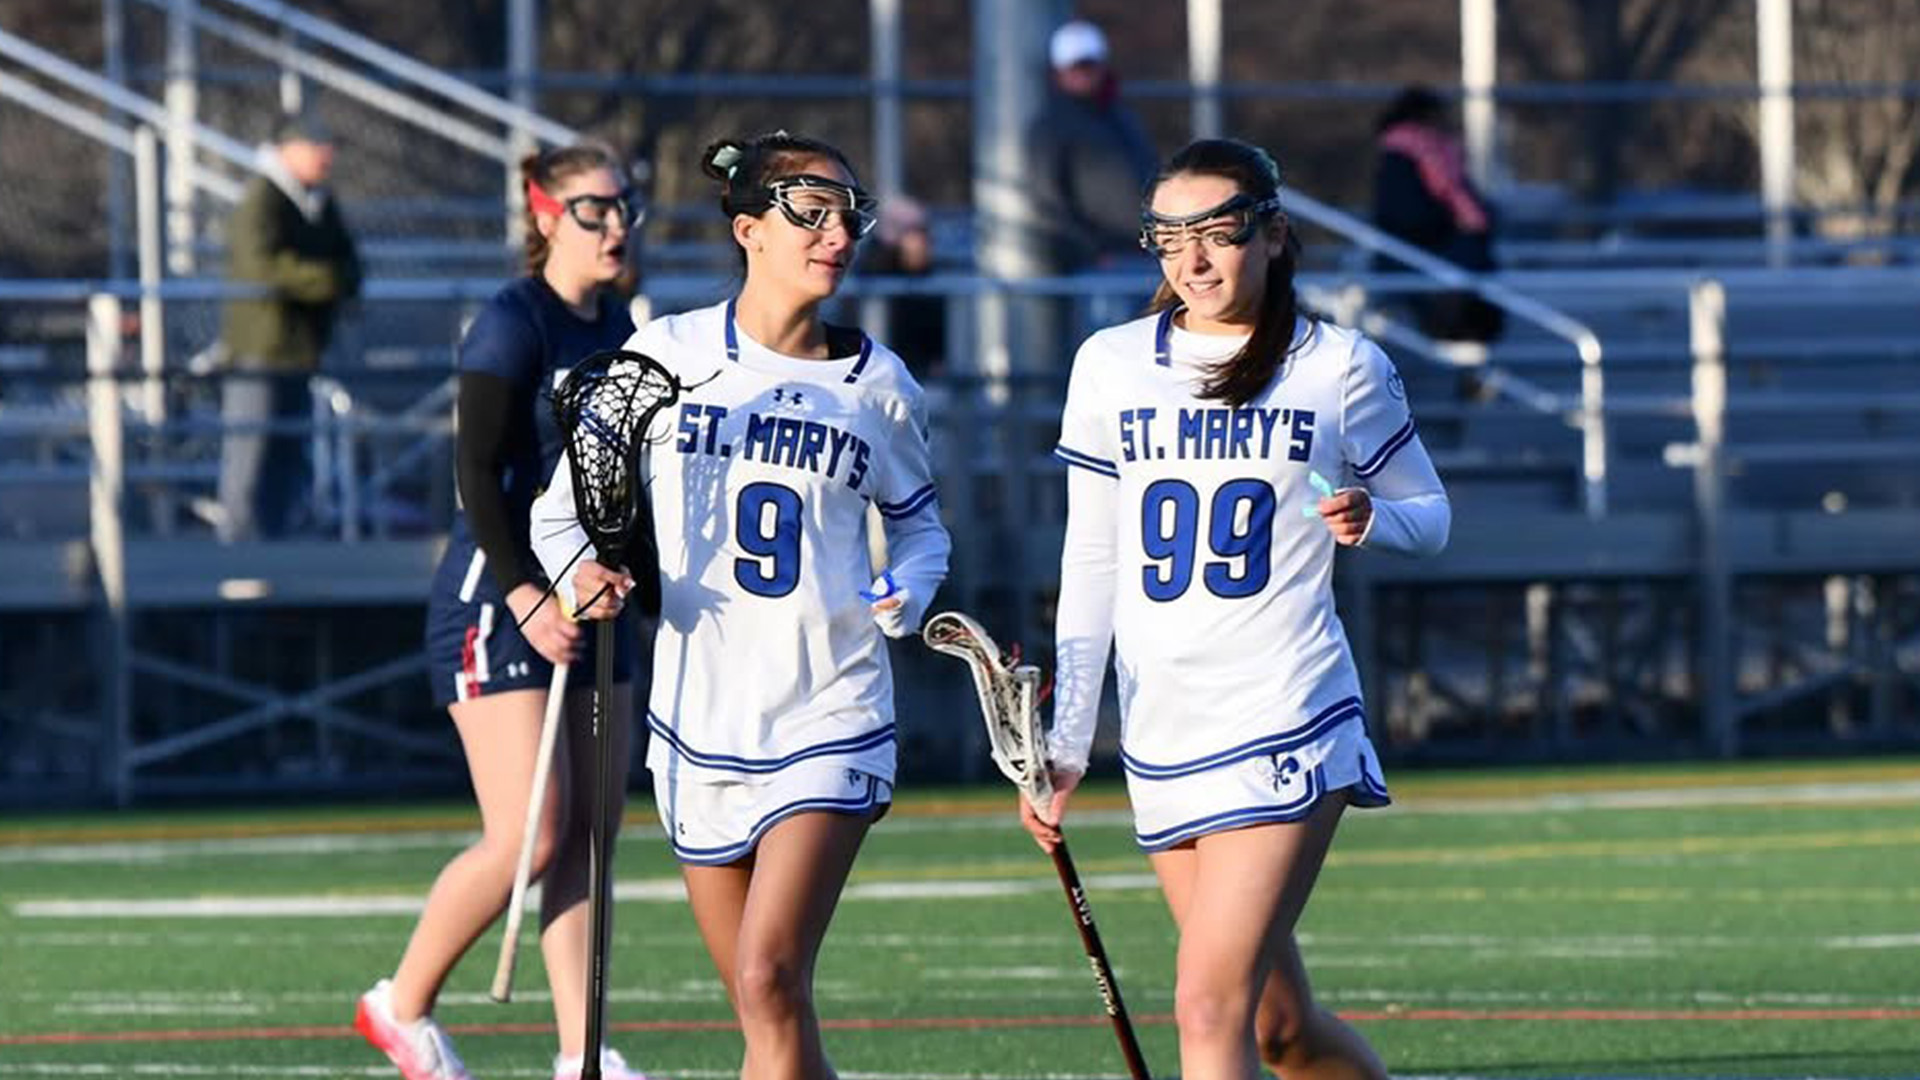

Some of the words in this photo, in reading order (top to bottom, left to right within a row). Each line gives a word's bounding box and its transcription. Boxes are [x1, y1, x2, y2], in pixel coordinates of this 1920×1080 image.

[677, 402, 731, 457] ST.
[744, 413, 870, 490] MARY'S
[1120, 408, 1165, 462] ST.
[1178, 408, 1315, 462] MARY'S
[734, 481, 803, 598] 9
[1142, 478, 1277, 602] 99
